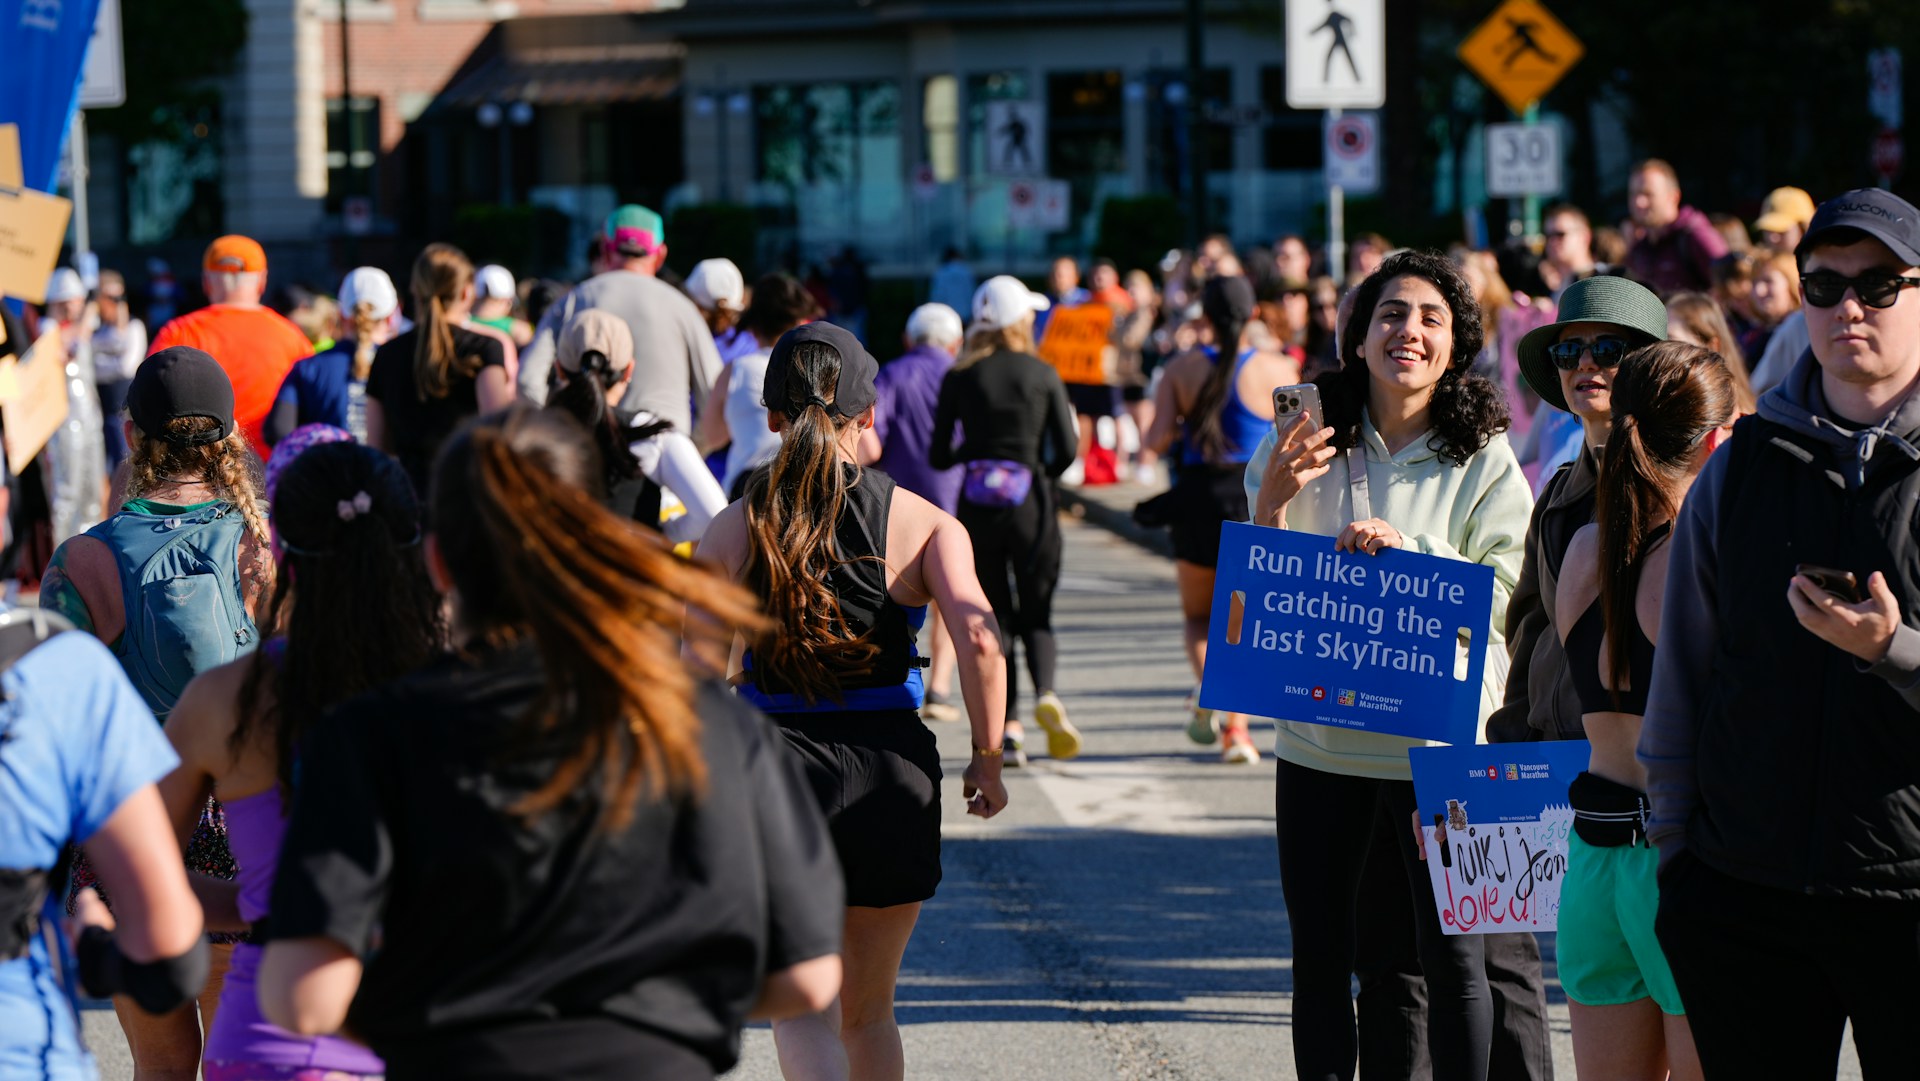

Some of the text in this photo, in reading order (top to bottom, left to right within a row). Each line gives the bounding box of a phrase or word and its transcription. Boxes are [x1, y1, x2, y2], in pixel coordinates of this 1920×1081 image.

[1248, 545, 1465, 605] Run like you're
[1263, 591, 1442, 639] catching the
[1252, 619, 1444, 678] last SkyTrain.
[1284, 685, 1309, 696] BMO
[1360, 692, 1403, 705] Vancouver
[1359, 700, 1399, 713] Marathon
[1469, 769, 1486, 778] BMO
[1519, 763, 1549, 771] Vancouver
[1521, 771, 1549, 779] Marathon
